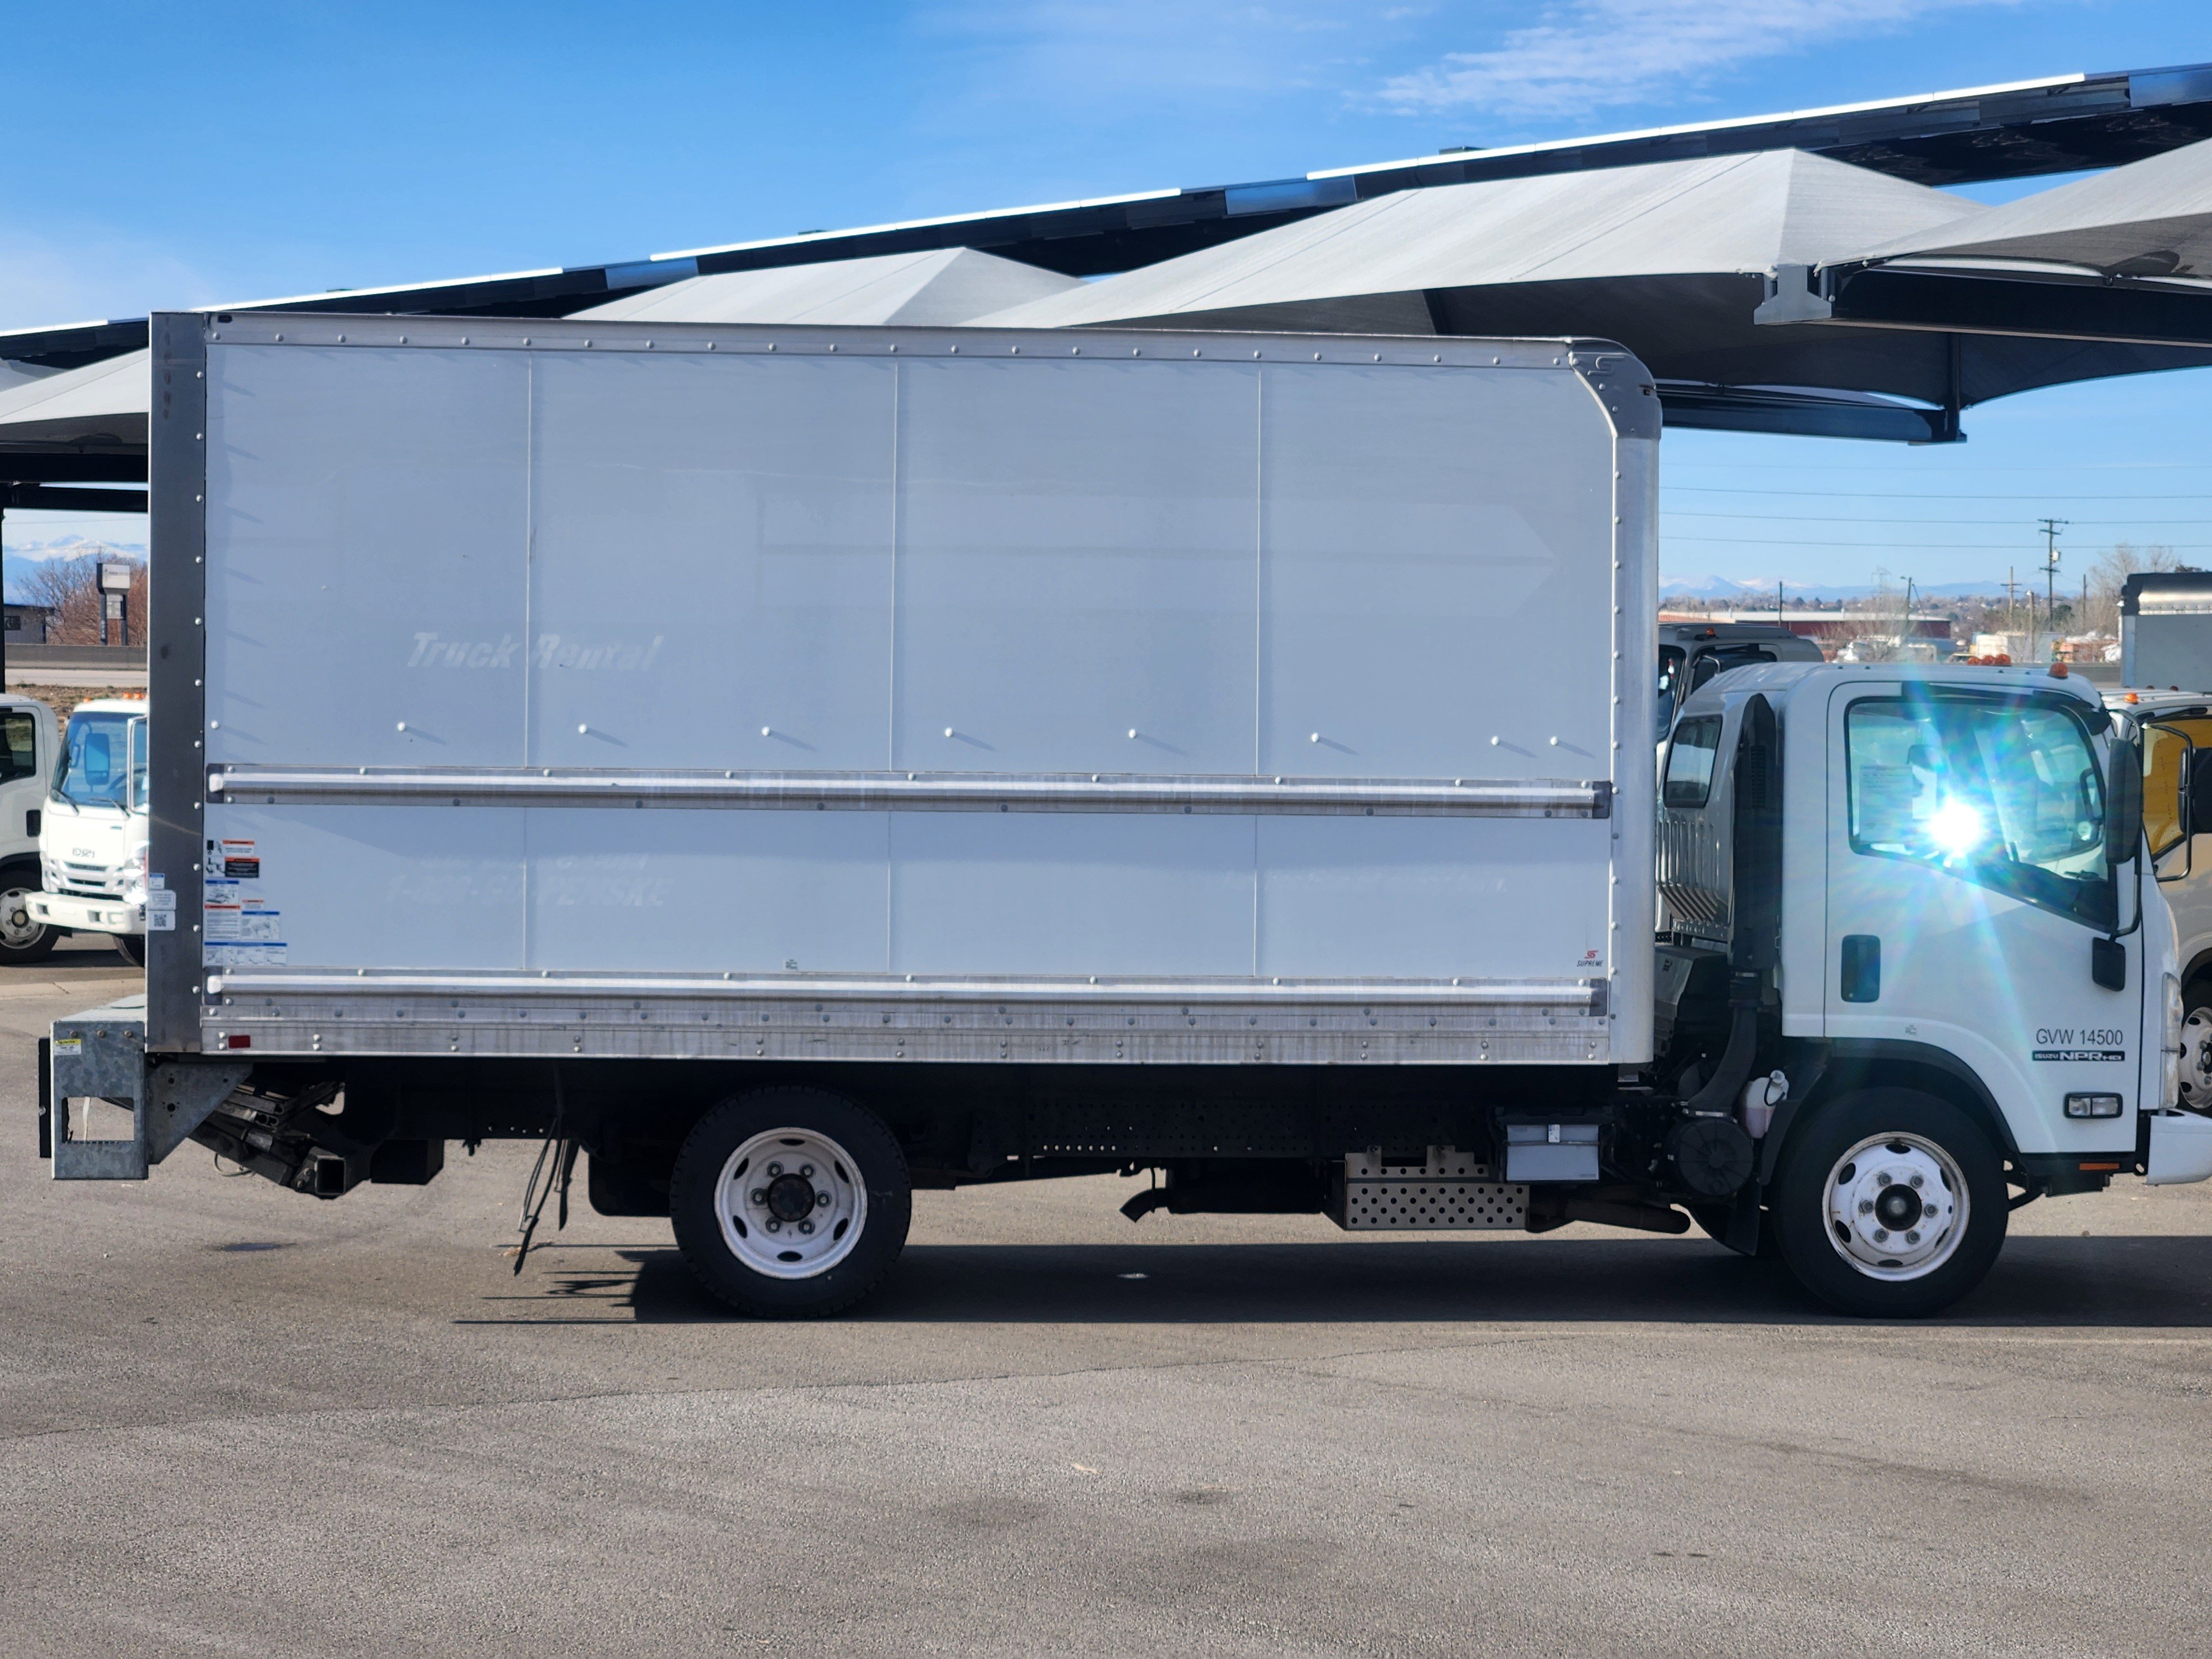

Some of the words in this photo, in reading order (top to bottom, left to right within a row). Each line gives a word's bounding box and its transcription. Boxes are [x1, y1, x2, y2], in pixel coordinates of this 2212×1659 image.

[408, 631, 521, 667] Truck
[533, 633, 664, 671] Rental
[2036, 1029, 2074, 1044] GVW
[2079, 1029, 2123, 1045] 14500
[2059, 1052, 2103, 1061] NPR
